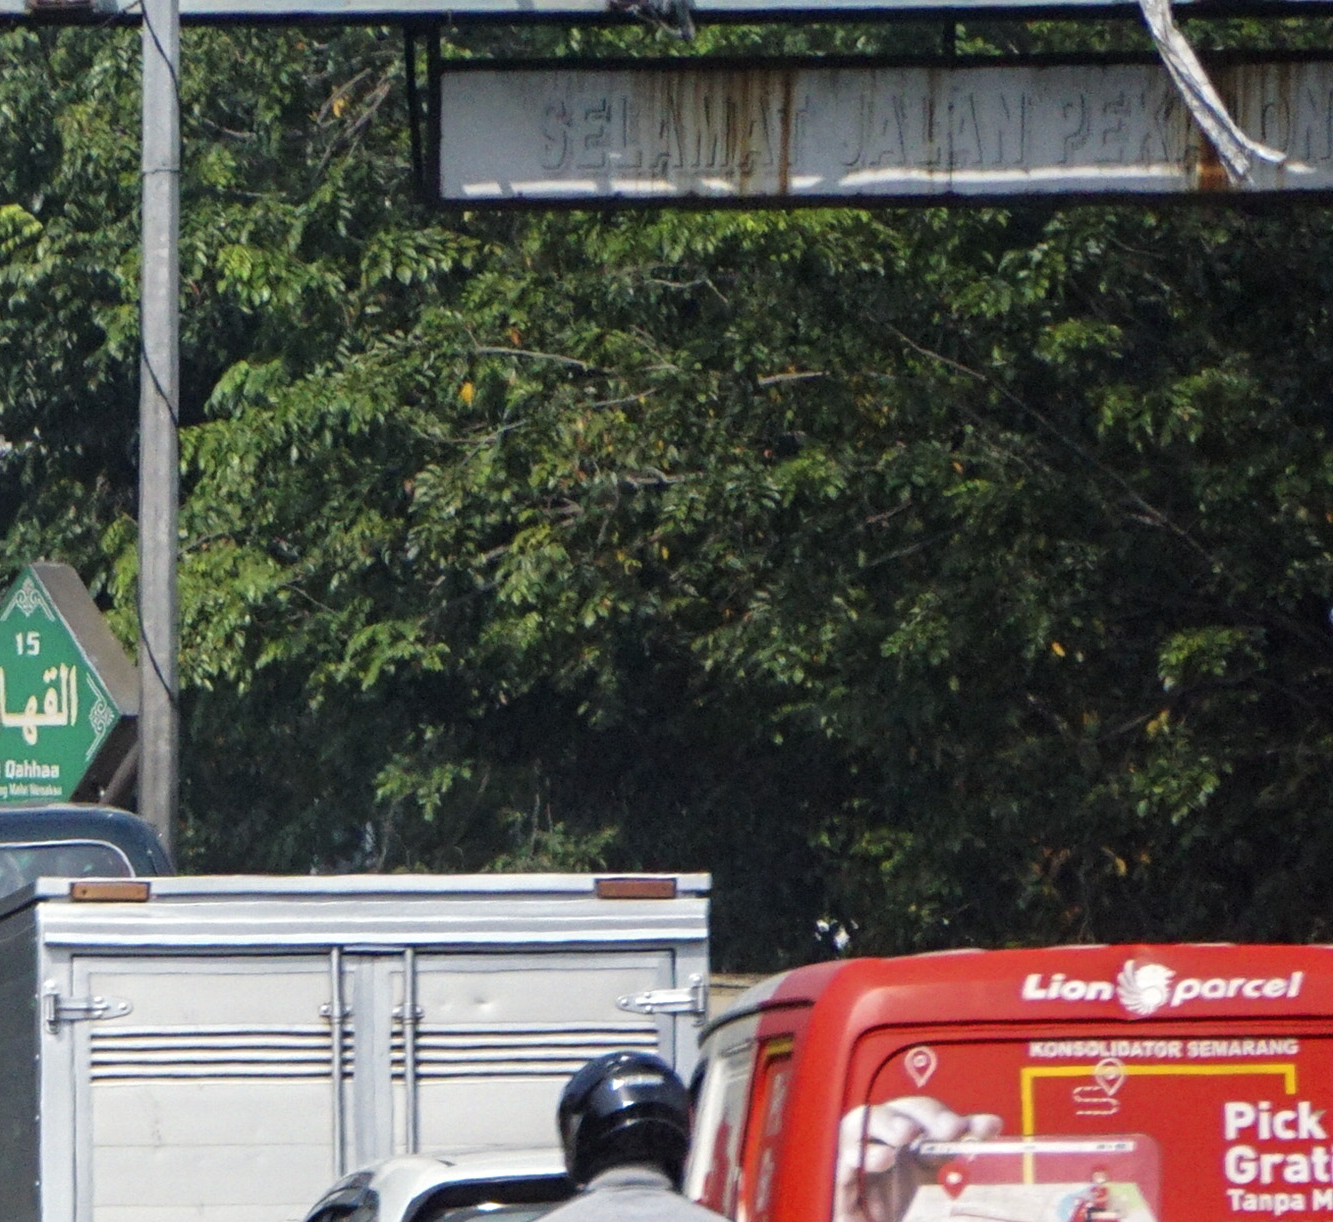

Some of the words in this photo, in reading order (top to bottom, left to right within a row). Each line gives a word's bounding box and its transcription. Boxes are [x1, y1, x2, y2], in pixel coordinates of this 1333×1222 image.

[538, 95, 809, 172] SELAMAT
[837, 92, 1026, 168] JALAN
[15, 631, 41, 656] 15
[1021, 973, 1115, 1001] Lion
[1170, 970, 1305, 1008] parcel
[1028, 1041, 1183, 1058] KONSOLIDATOR
[1186, 1038, 1300, 1057] SEMARANG
[1224, 1100, 1328, 1141] Pick
[1225, 1145, 1333, 1185] Grat
[1226, 1188, 1306, 1216] Tanpa
